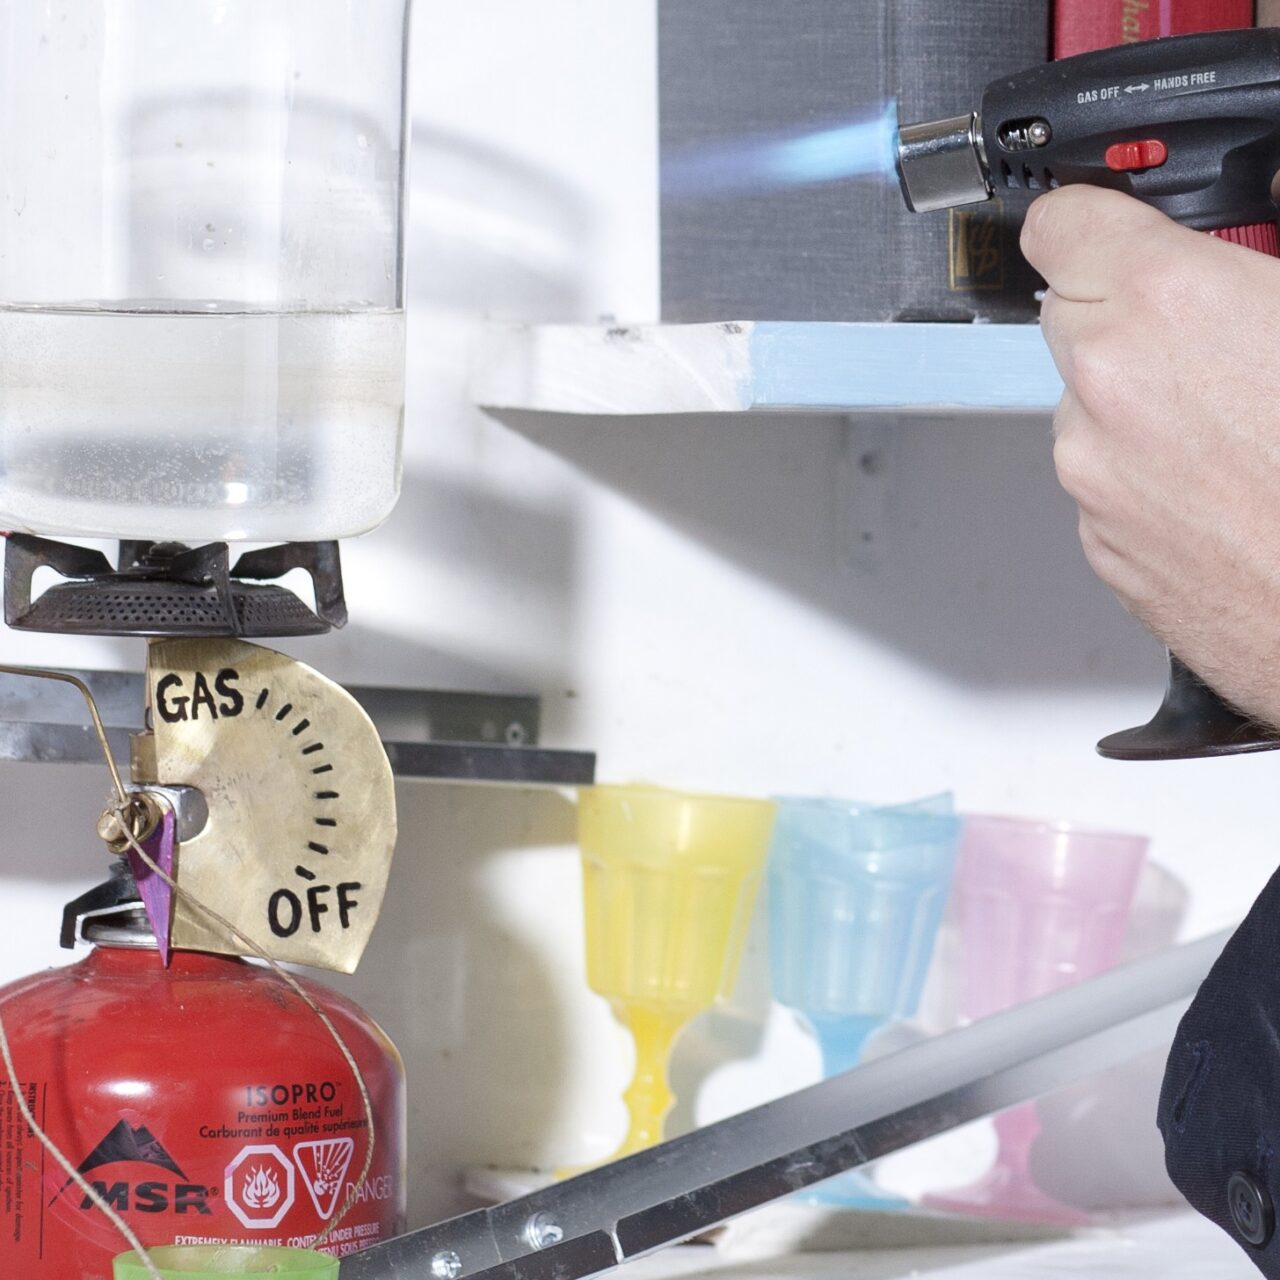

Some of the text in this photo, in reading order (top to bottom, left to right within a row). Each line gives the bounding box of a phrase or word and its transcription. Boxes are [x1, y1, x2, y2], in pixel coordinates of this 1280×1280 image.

[1077, 71, 1216, 104] GAS OFF HANDS FREE
[156, 668, 244, 723] GAS
[268, 881, 362, 937] OFF
[247, 1081, 336, 1107] ISOPRO
[238, 1104, 343, 1124] Premium Blend Fuel
[199, 1124, 262, 1139] Carburant
[266, 1123, 280, 1138] de
[284, 1120, 320, 1138] qualité
[81, 1181, 212, 1215] MSR
[329, 1227, 353, 1243] UNDER
